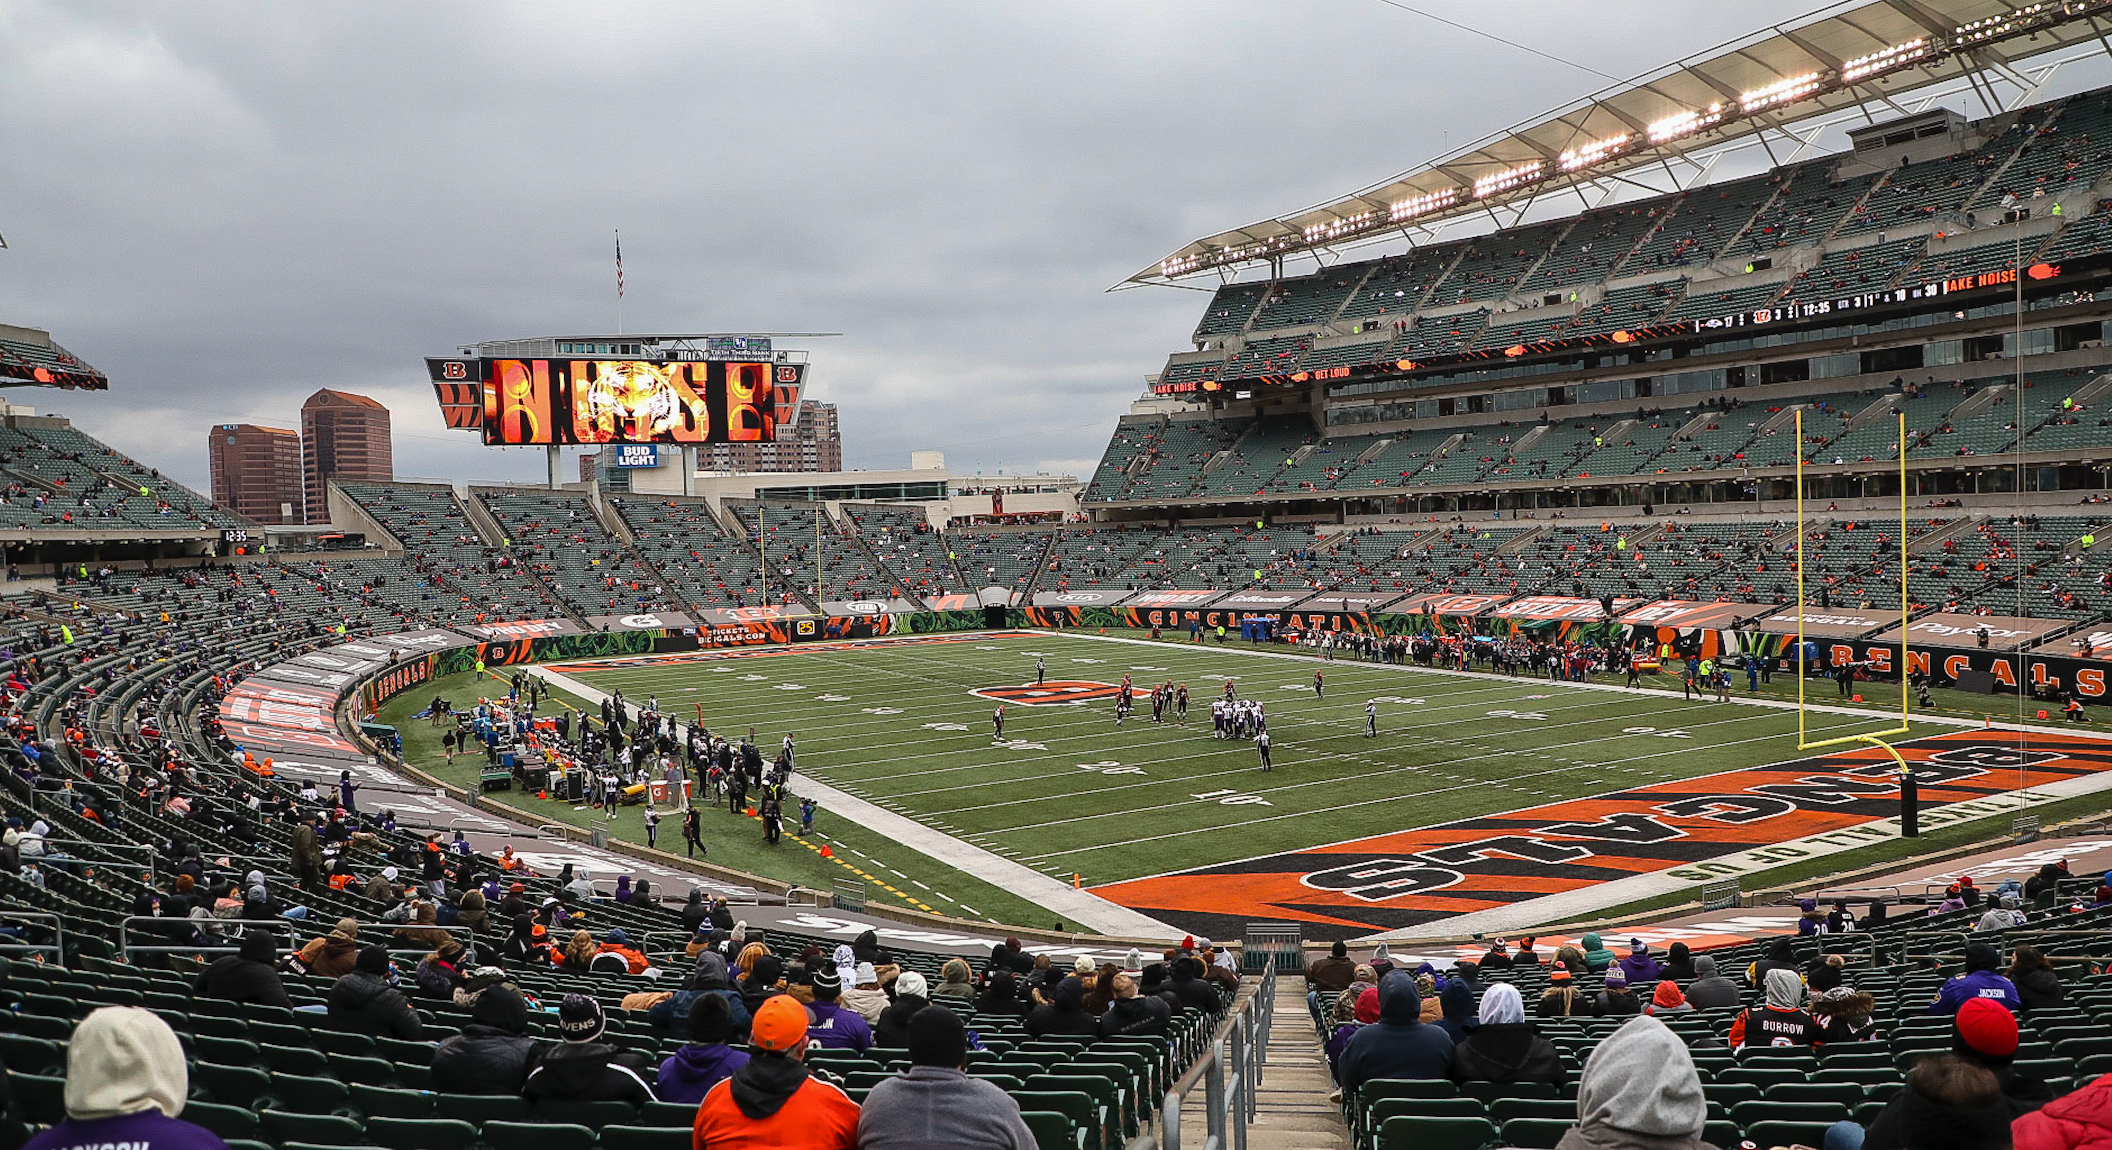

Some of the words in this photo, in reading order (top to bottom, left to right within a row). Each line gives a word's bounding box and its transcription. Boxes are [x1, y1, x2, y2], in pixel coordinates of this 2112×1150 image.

[1978, 268, 2018, 287] NOISE
[1723, 316, 1733, 327] 17
[1775, 309, 1782, 320] 3
[1803, 301, 1830, 316] 12:35
[1854, 296, 1862, 308] 3
[1895, 289, 1907, 302] 10
[1924, 284, 1938, 297] 30
[1314, 369, 1328, 381] GET
[1330, 367, 1350, 379] LOUD
[1174, 382, 1197, 393] NOISE
[623, 446, 650, 457] BUD
[618, 455, 655, 466] LIGHT
[225, 530, 247, 542] 12:35
[526, 621, 564, 633] DEY
[800, 622, 814, 633] 25
[1829, 644, 2106, 697] BENGALS
[1076, 760, 1143, 776] 20
[1189, 788, 1265, 807] 10
[1298, 745, 2071, 903] BENGALS
[1802, 826, 1893, 847] ALL
[1745, 847, 1811, 865] OF
[1666, 862, 1746, 882] US
[1978, 988, 2006, 999] JACKSON
[1762, 1020, 1804, 1036] BURROW
